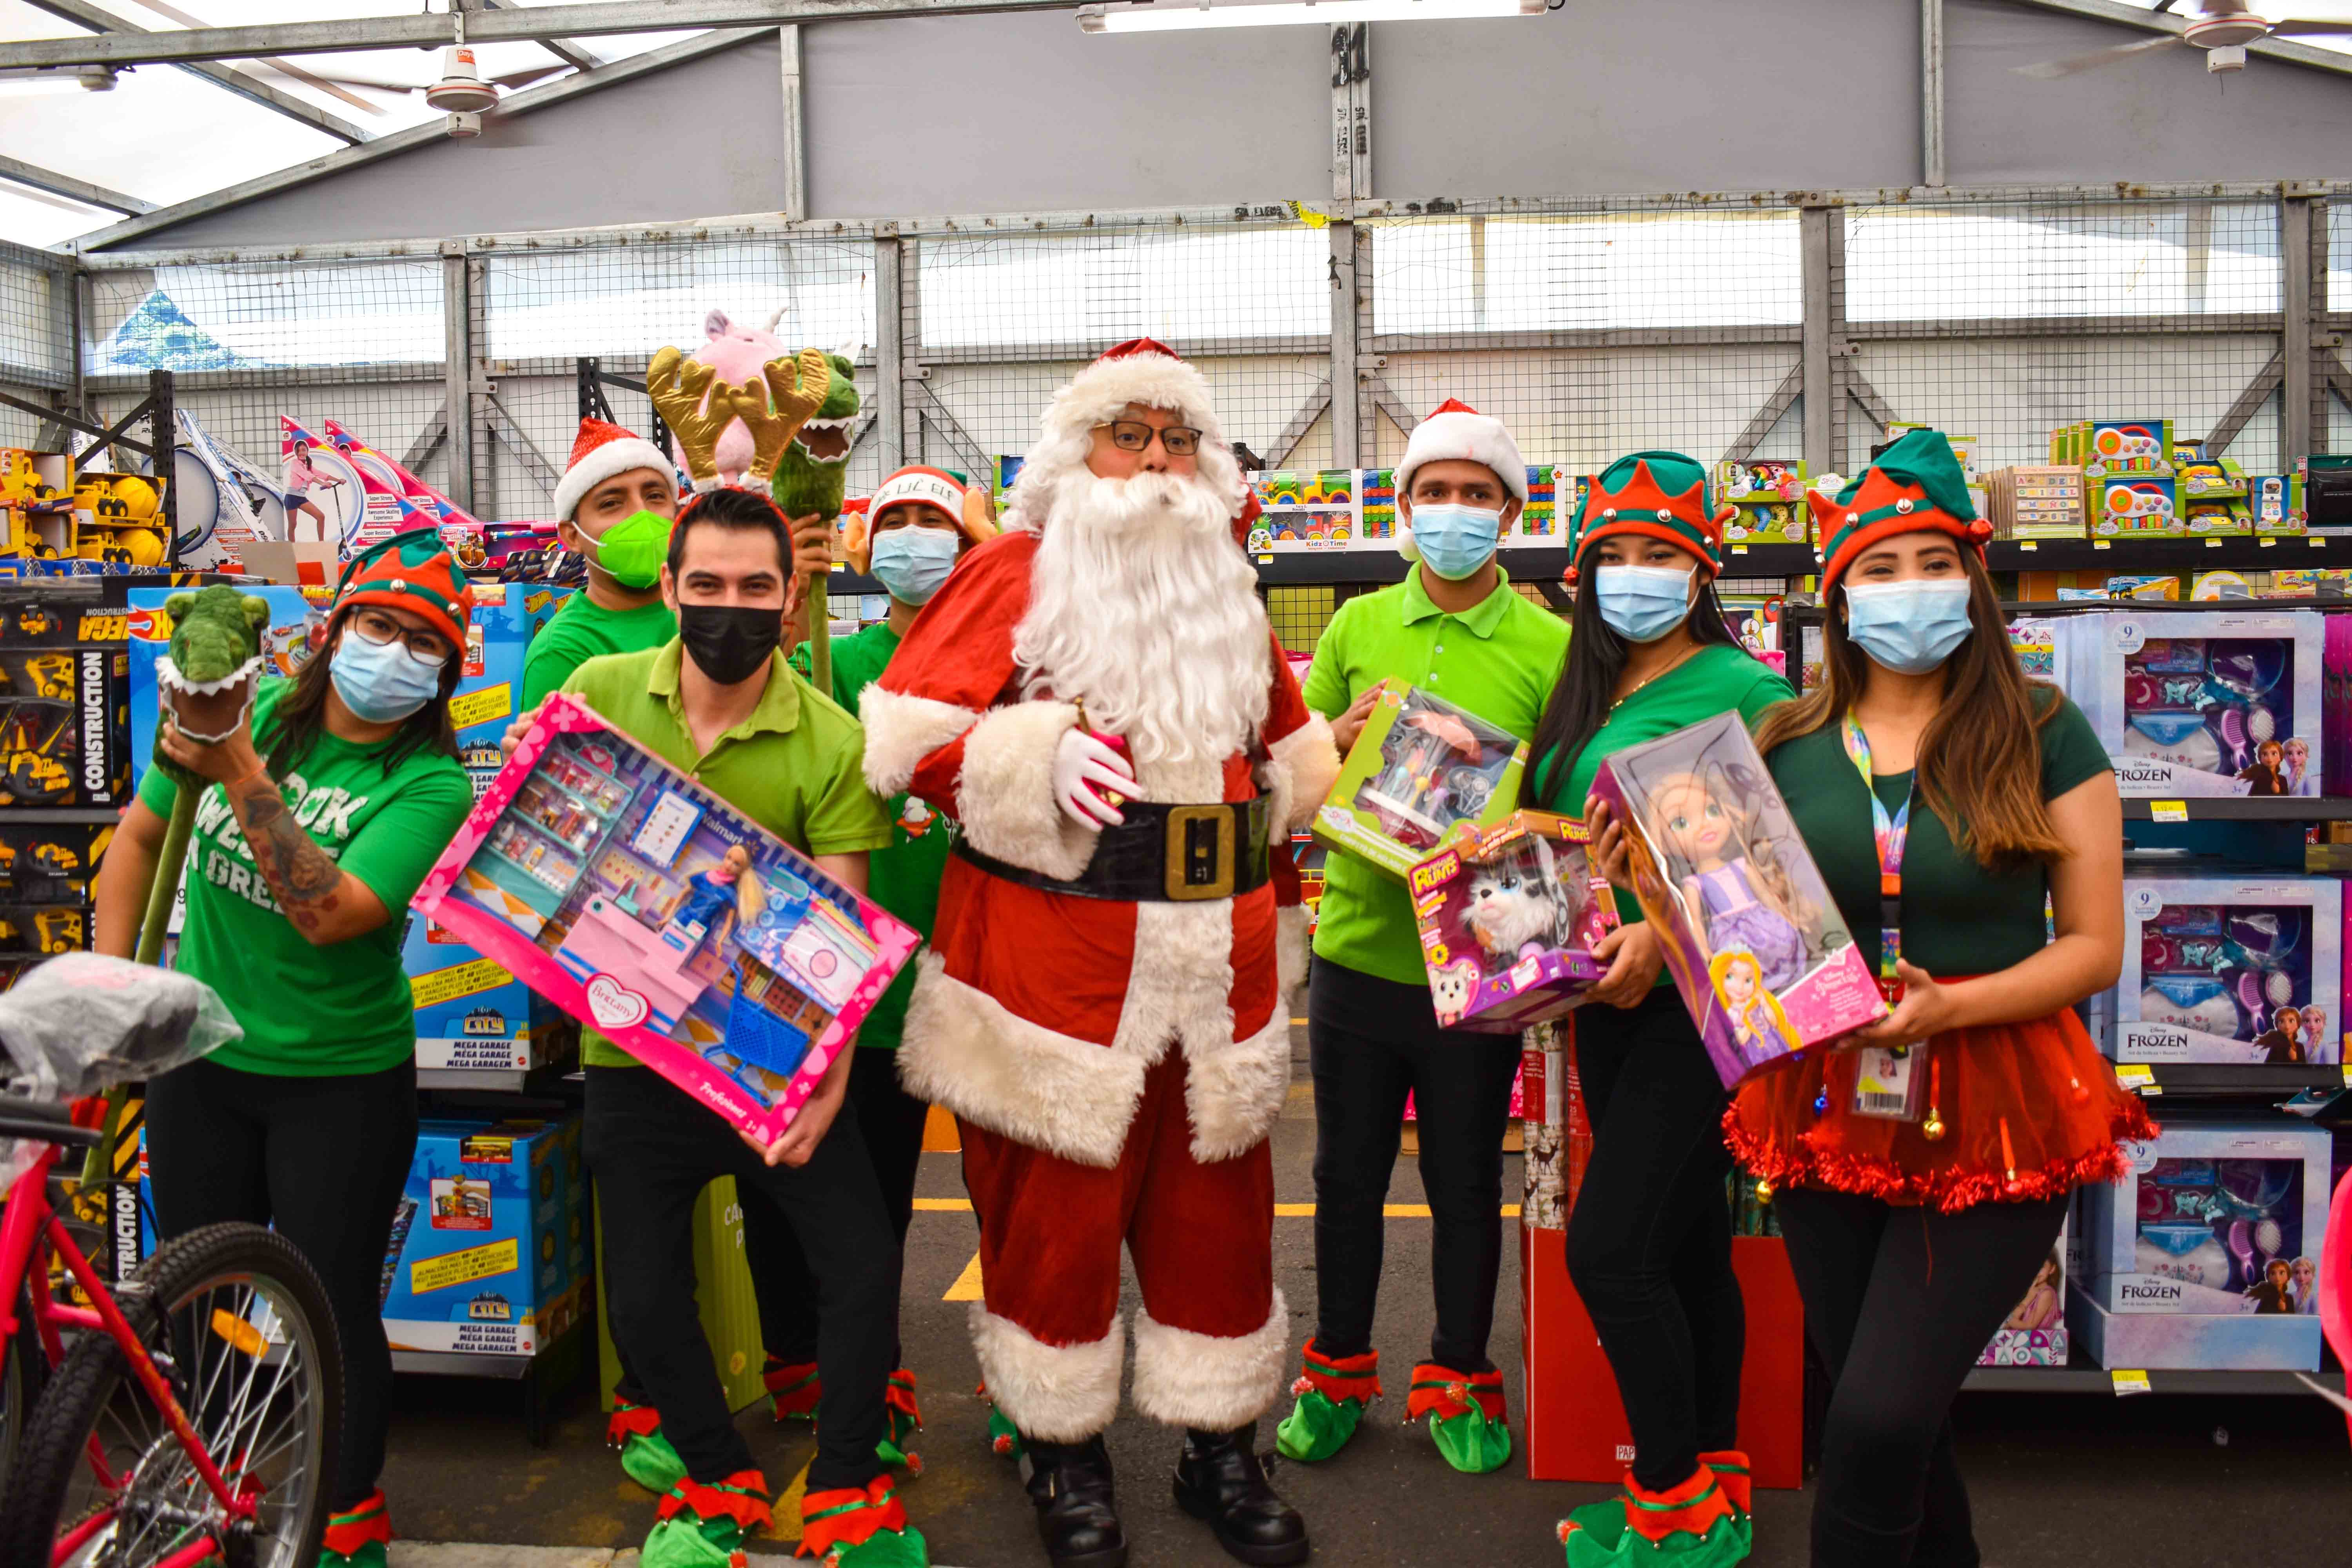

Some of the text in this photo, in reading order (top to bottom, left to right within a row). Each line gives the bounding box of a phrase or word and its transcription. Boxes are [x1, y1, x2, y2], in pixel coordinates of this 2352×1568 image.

[303, 588, 335, 597] MEG
[87, 607, 128, 616] STRUCTION
[2123, 626, 2133, 639] 9
[83, 652, 105, 790] CONSTRUCTION
[2115, 768, 2171, 782] FROZEN
[2140, 893, 2150, 905] 9
[454, 1041, 512, 1049] MEGA GARAGE
[2127, 1034, 2188, 1048] FROZEN
[479, 1051, 512, 1059] GARAGE
[472, 1060, 512, 1068] GARAGEM
[2136, 1146, 2145, 1158] 9
[116, 1185, 137, 1281] STRUCTION
[2121, 1285, 2181, 1299] FROZEN
[459, 1325, 517, 1334] MEGA GARAGE
[485, 1335, 517, 1343] GARAGE
[452, 1343, 517, 1352] MEGA GARAGEM
[1617, 1446, 1635, 1459] PAP
